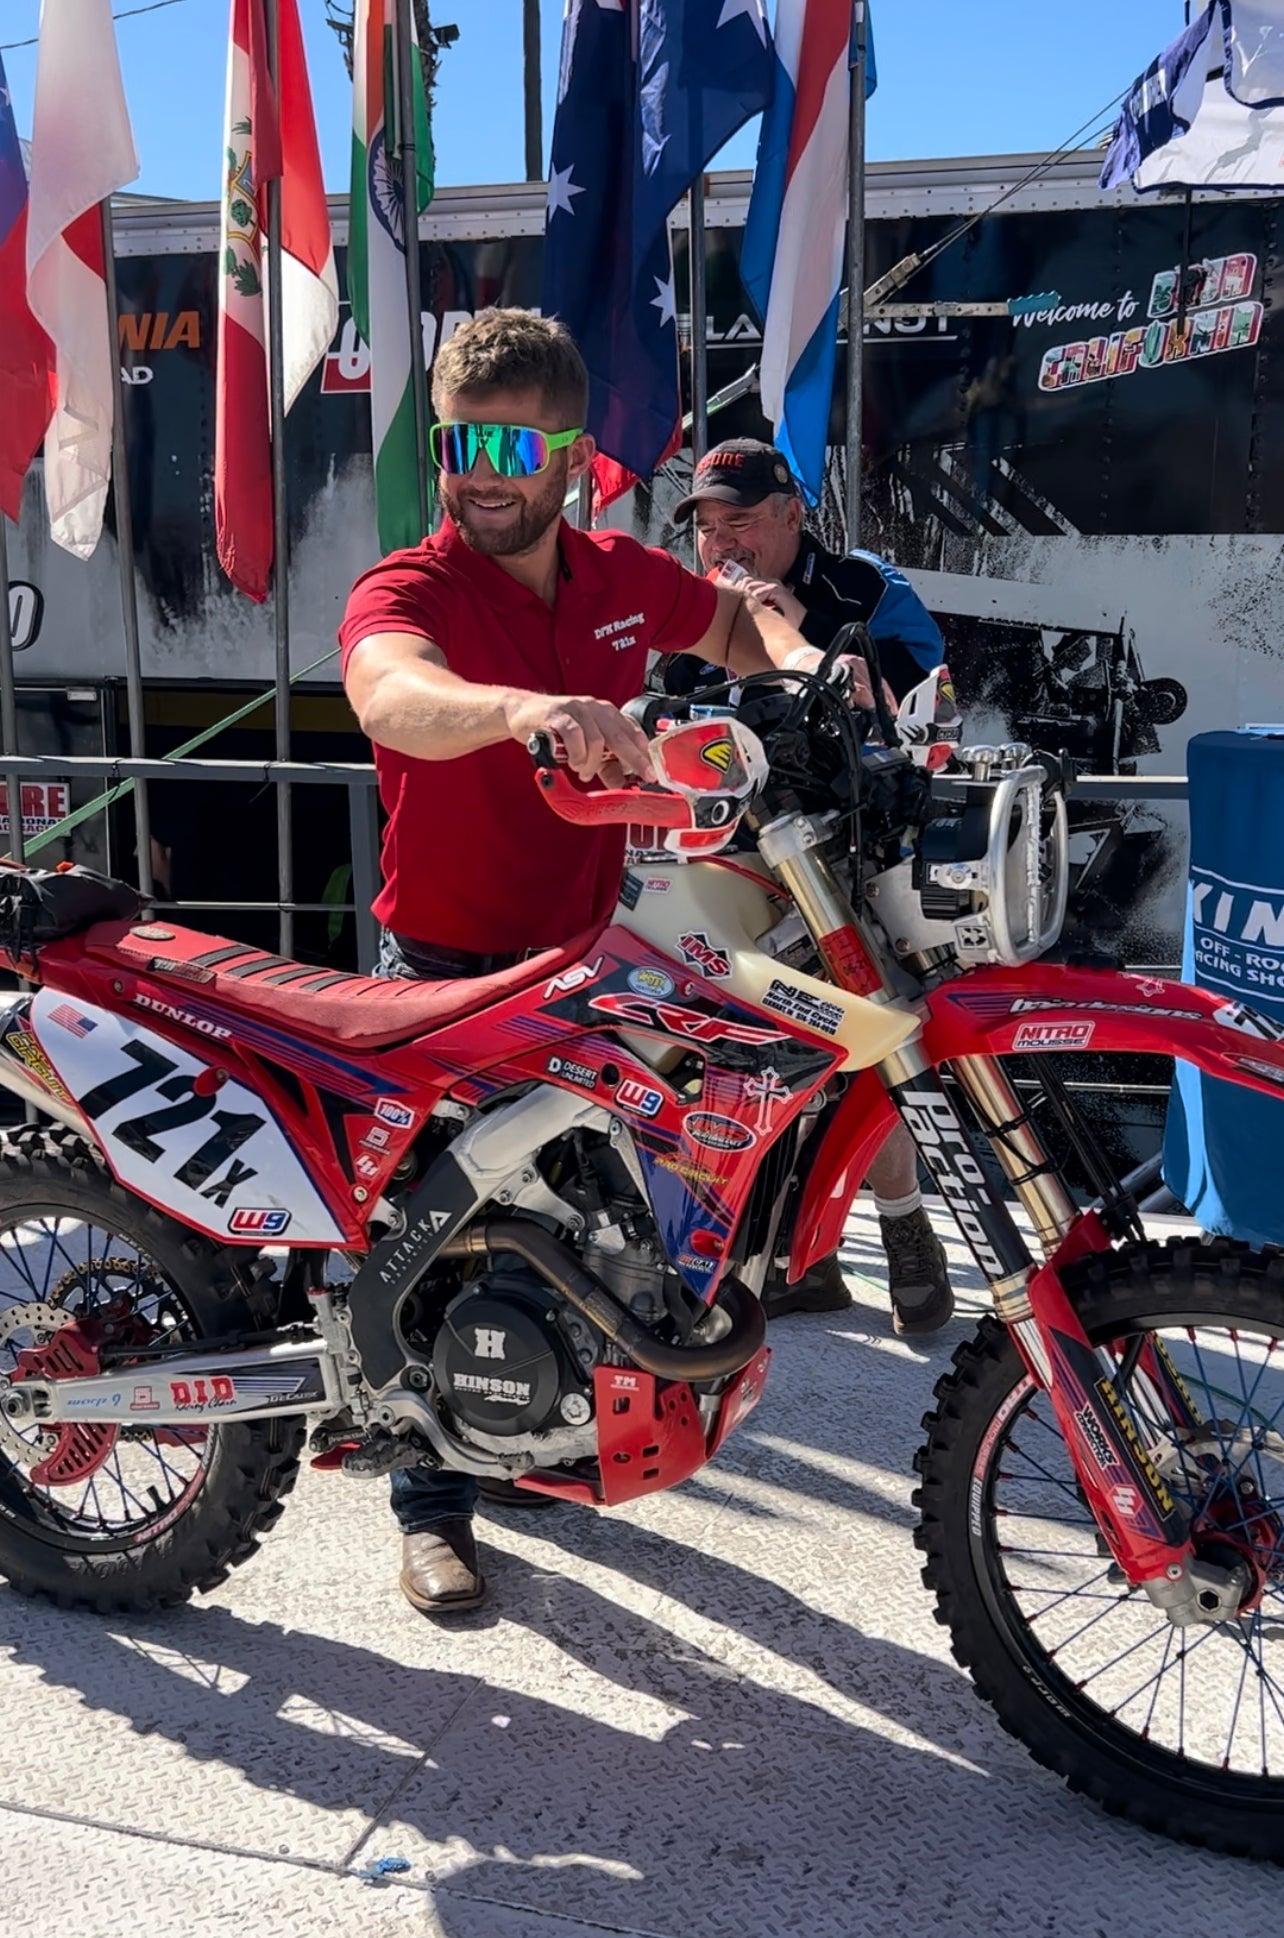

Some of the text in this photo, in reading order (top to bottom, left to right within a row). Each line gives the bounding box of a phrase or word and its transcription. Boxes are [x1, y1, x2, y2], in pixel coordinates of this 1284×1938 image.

[1117, 290, 1140, 322] to
[680, 934, 730, 976] IMS
[1200, 937, 1230, 957] OFF
[133, 993, 233, 1040] DUNLOP
[766, 991, 838, 1028] North End Cycle
[1020, 1025, 1090, 1040] NITRO
[6, 1033, 73, 1101] CIRCUIT
[561, 1070, 597, 1088] UNLIMITED
[563, 1061, 597, 1080] DESERT
[380, 1104, 410, 1124] 100%
[680, 1167, 728, 1184] CIRCUIT
[380, 1218, 431, 1283] ATTACK
[474, 1328, 506, 1360] H
[170, 1376, 236, 1404] DID
[453, 1373, 530, 1396] HINSON
[614, 1375, 636, 1387] TM
[1075, 1412, 1108, 1467] CONNECTION
[1083, 1405, 1118, 1463] WORKS
[1101, 1381, 1174, 1512] HINSON
[971, 1477, 983, 1537] EQUIPPED
